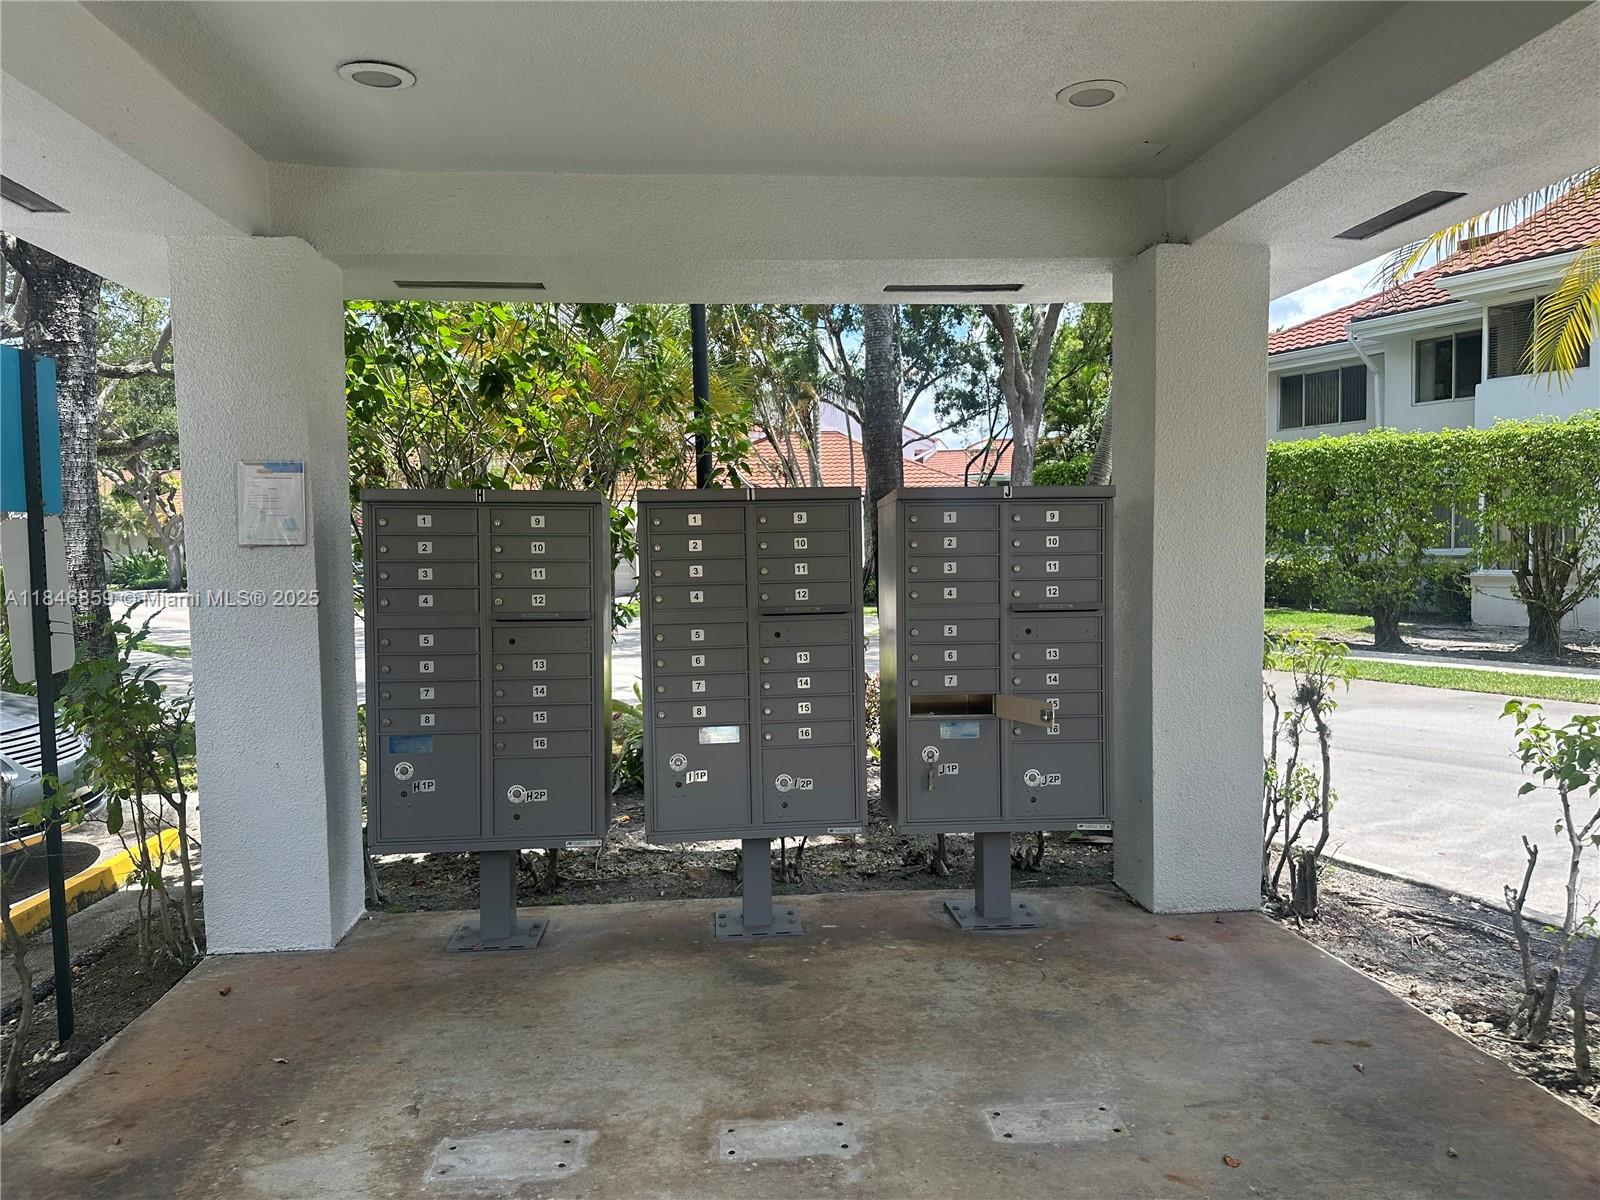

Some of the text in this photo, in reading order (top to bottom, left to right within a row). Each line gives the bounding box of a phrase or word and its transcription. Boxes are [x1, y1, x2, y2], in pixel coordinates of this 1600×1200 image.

[476, 489, 484, 502] H
[1004, 486, 1011, 497] J
[796, 539, 806, 547] 10
[1048, 537, 1058, 546] 10
[532, 543, 544, 552] 10
[796, 565, 807, 573] 11
[1047, 562, 1057, 570] 11
[533, 570, 543, 578] 11
[797, 590, 807, 598] 12
[1047, 587, 1058, 596] 12
[533, 596, 544, 604] 12
[798, 653, 809, 662] 13
[1047, 650, 1058, 658] 13
[534, 660, 545, 669] 13
[798, 678, 809, 687] 14
[1048, 675, 1058, 683] 14
[534, 687, 545, 695] 14
[799, 704, 810, 712] 15
[534, 713, 546, 721] 15
[800, 729, 810, 737] 16
[535, 739, 546, 747] 16
[695, 772, 706, 780] 1P
[414, 781, 434, 792] H 1P
[526, 791, 546, 801] H 2P
